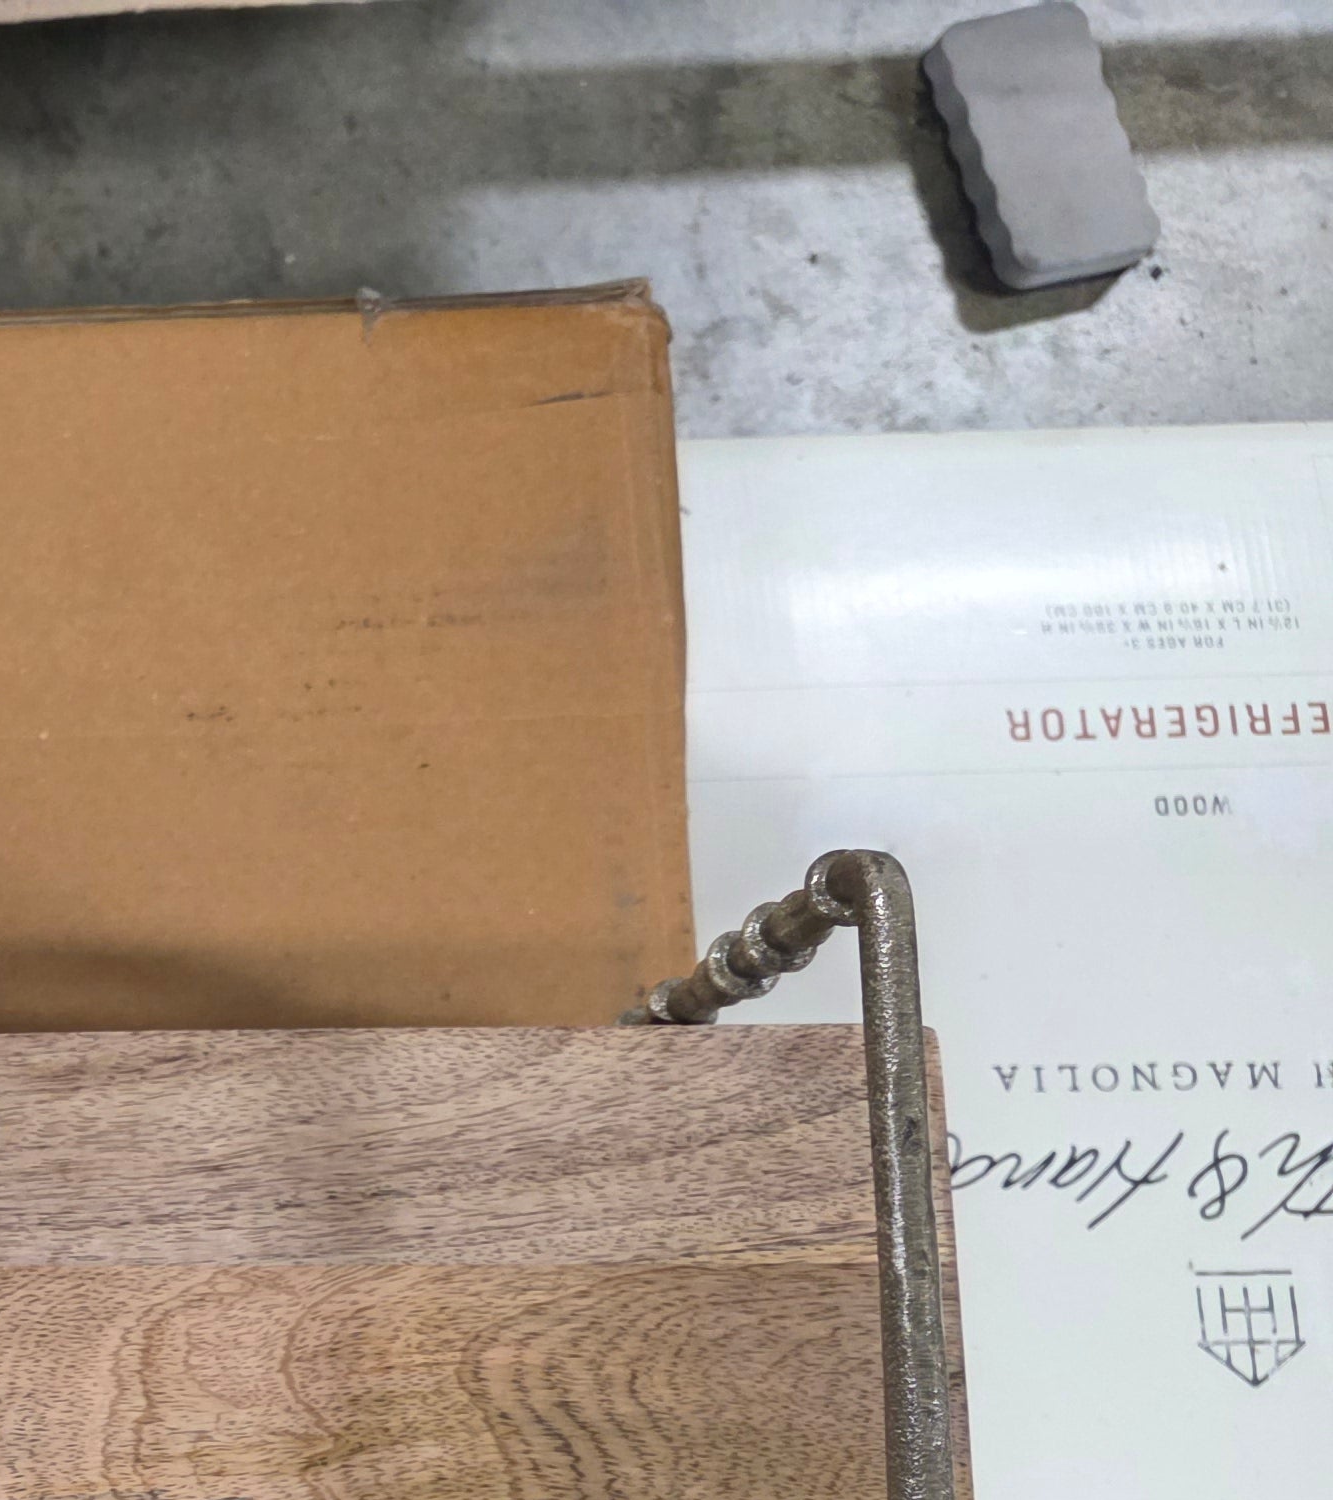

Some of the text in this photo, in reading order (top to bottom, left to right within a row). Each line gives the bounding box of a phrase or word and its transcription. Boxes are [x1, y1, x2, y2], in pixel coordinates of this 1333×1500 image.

[1147, 637, 1186, 649] AGES
[1195, 636, 1224, 648] FOR
[1154, 793, 1233, 817] WOOD
[993, 1061, 1282, 1094] MAGNOLIA
[1188, 1128, 1248, 1221] &
